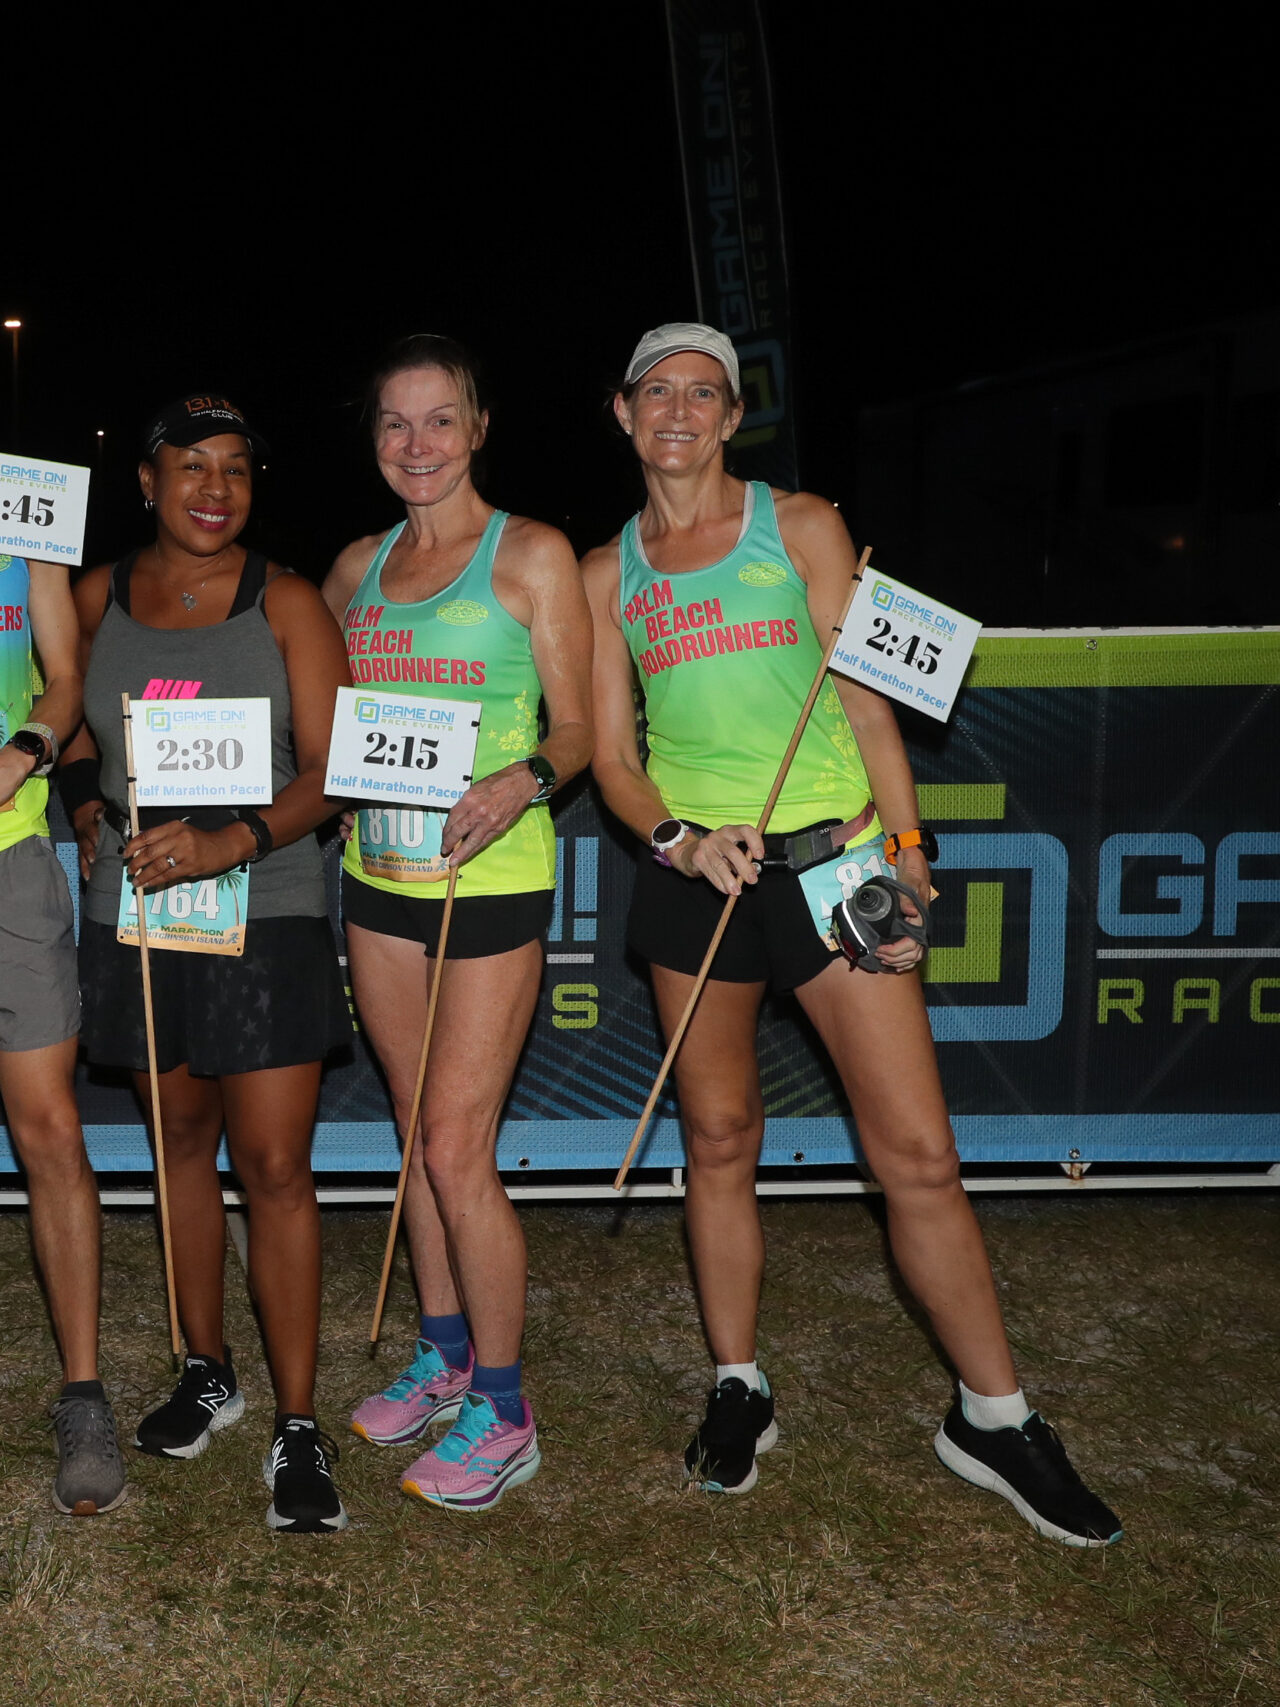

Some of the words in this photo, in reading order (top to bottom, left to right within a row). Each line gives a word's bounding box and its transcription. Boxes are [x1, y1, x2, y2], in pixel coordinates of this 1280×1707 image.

[0, 464, 41, 480] GAME
[44, 471, 67, 486] ON!
[0, 477, 24, 486] RACE
[29, 481, 66, 493] EVENTS
[45, 541, 78, 556] Pacer
[624, 579, 674, 626] PALM
[894, 595, 934, 622] GAME
[934, 615, 957, 634] ON!
[645, 598, 724, 643] BEACH
[891, 608, 914, 624] RACE
[917, 621, 954, 642] EVENTS
[346, 629, 414, 656] BEACH
[638, 618, 799, 678] ROADRUNNERS
[865, 617, 943, 675] 2:45
[349, 657, 486, 685] ADRUNNERS
[833, 647, 859, 667] Half
[859, 660, 914, 695] Marathon
[916, 687, 948, 711] Pacer
[141, 678, 203, 700] RUN
[173, 711, 216, 721] GAME
[220, 710, 246, 721] ON!
[381, 718, 408, 727] RACE
[413, 721, 454, 732] EVENTS
[382, 705, 426, 719] GAME
[429, 710, 455, 723] ON!
[156, 738, 244, 771] 2:30
[363, 732, 440, 770] 2:15
[163, 785, 226, 797] Marathon
[231, 784, 267, 795] Pacer
[330, 775, 358, 788] Half
[361, 777, 423, 795] Marathon
[427, 785, 464, 800] Pacer
[367, 809, 425, 848] 810
[378, 854, 431, 864] MARATHON
[403, 863, 433, 872] ISLAND
[161, 924, 224, 937] MARATHON
[196, 936, 225, 945] ISLAND
